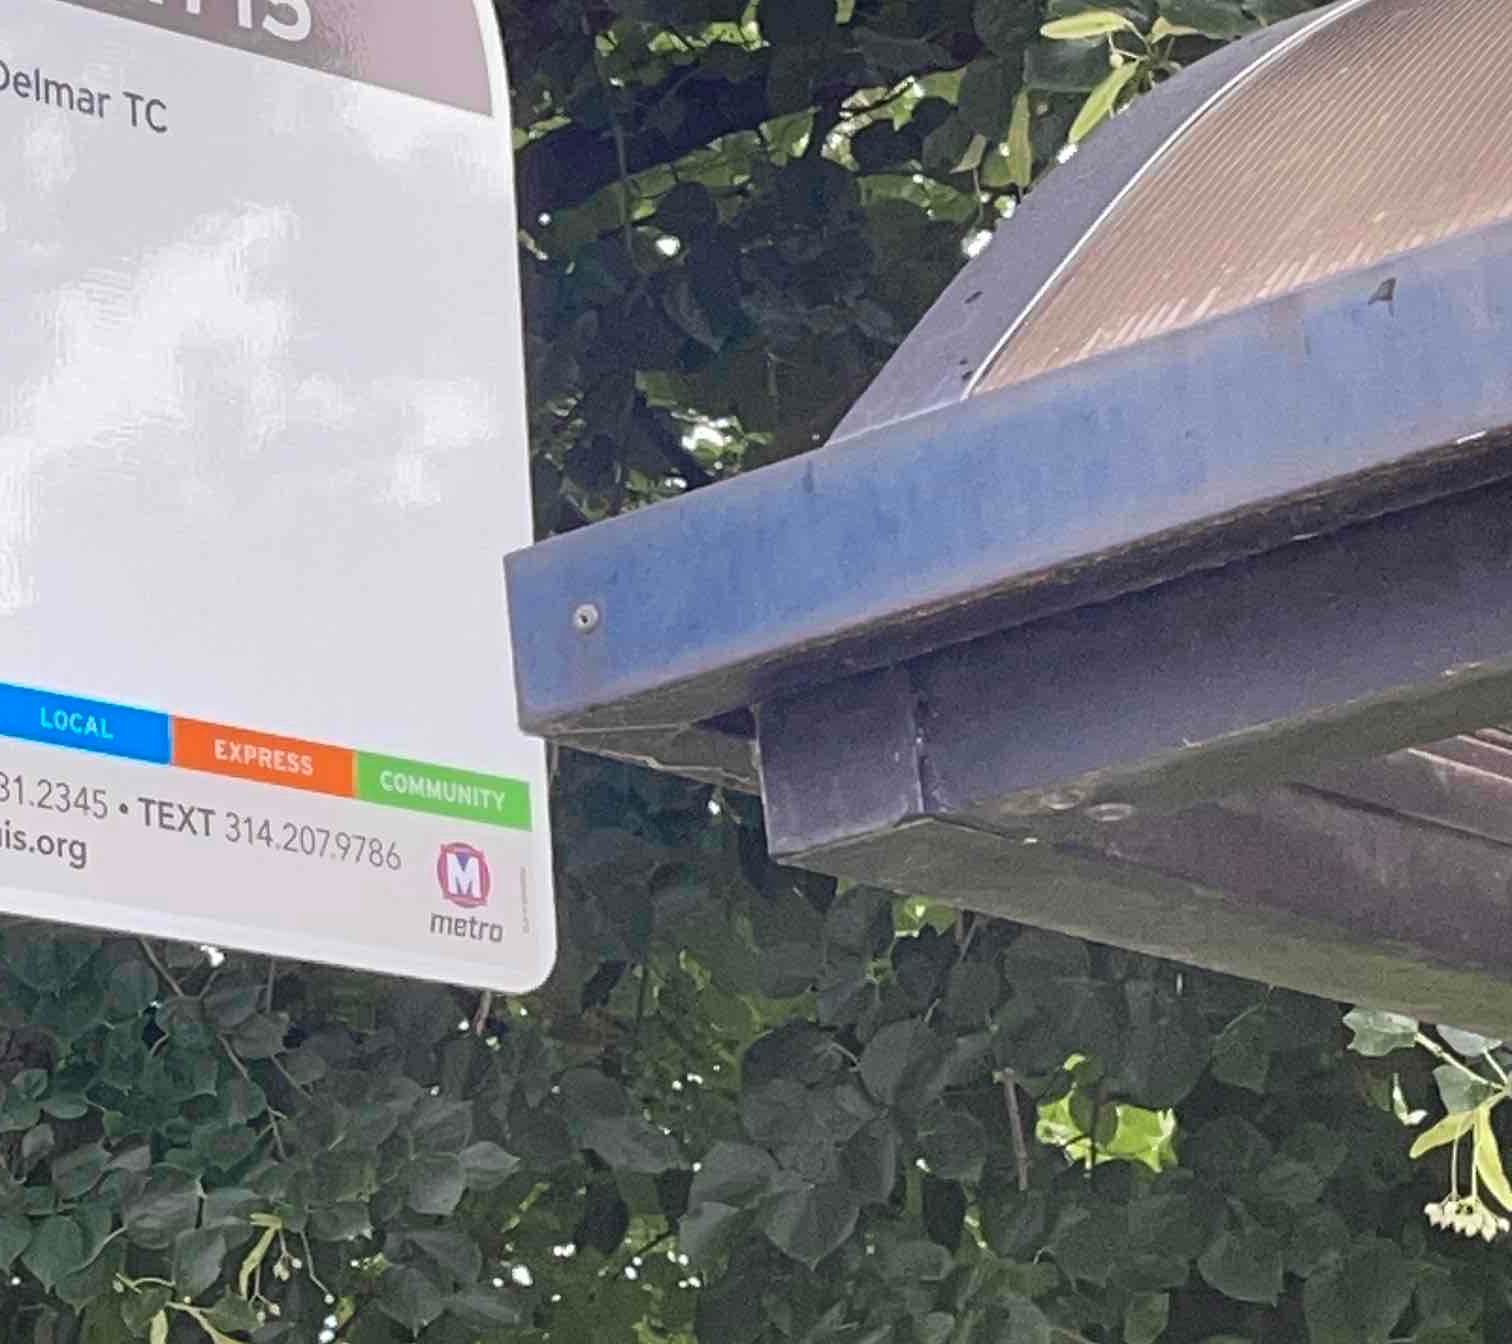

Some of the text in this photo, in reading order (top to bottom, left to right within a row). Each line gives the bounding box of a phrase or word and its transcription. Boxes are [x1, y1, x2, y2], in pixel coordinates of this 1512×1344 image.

[123, 92, 169, 134] TC
[39, 706, 114, 740] LOCAL
[213, 738, 313, 776] EXPRESS
[379, 769, 506, 812] COMMUNITY
[138, 796, 216, 837] TEXT
[225, 812, 402, 871] 314.207.9786
[429, 909, 504, 943] metro
